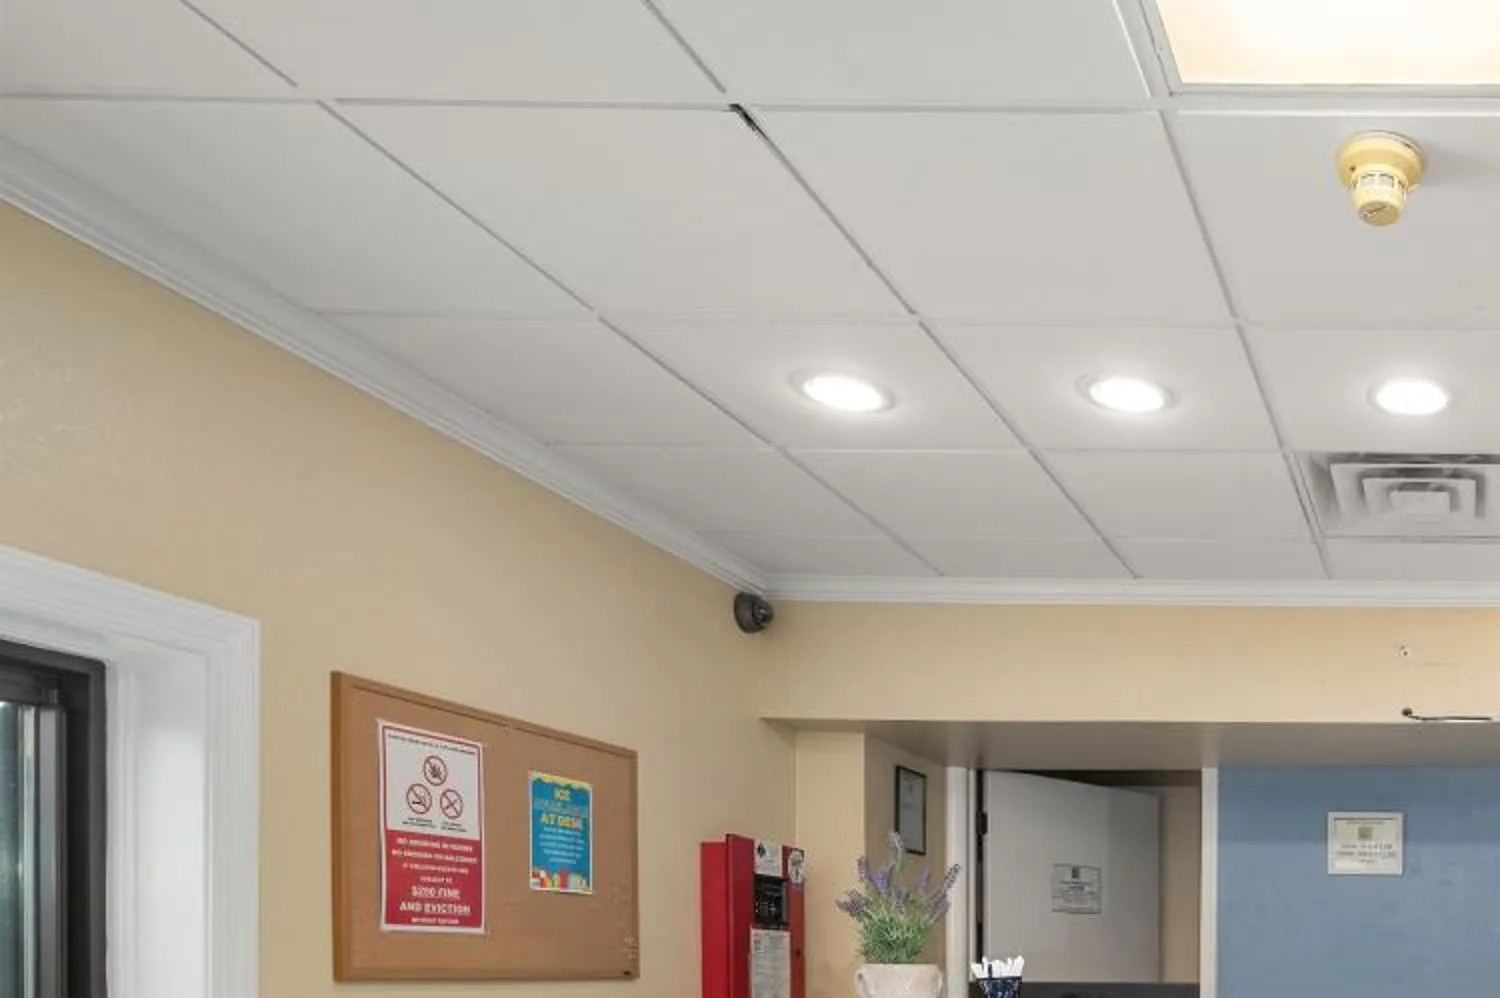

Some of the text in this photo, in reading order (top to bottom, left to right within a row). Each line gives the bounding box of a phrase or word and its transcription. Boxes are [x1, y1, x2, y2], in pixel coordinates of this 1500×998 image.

[541, 812, 584, 830] AT DESK
[399, 901, 472, 916] AND EVICTION
